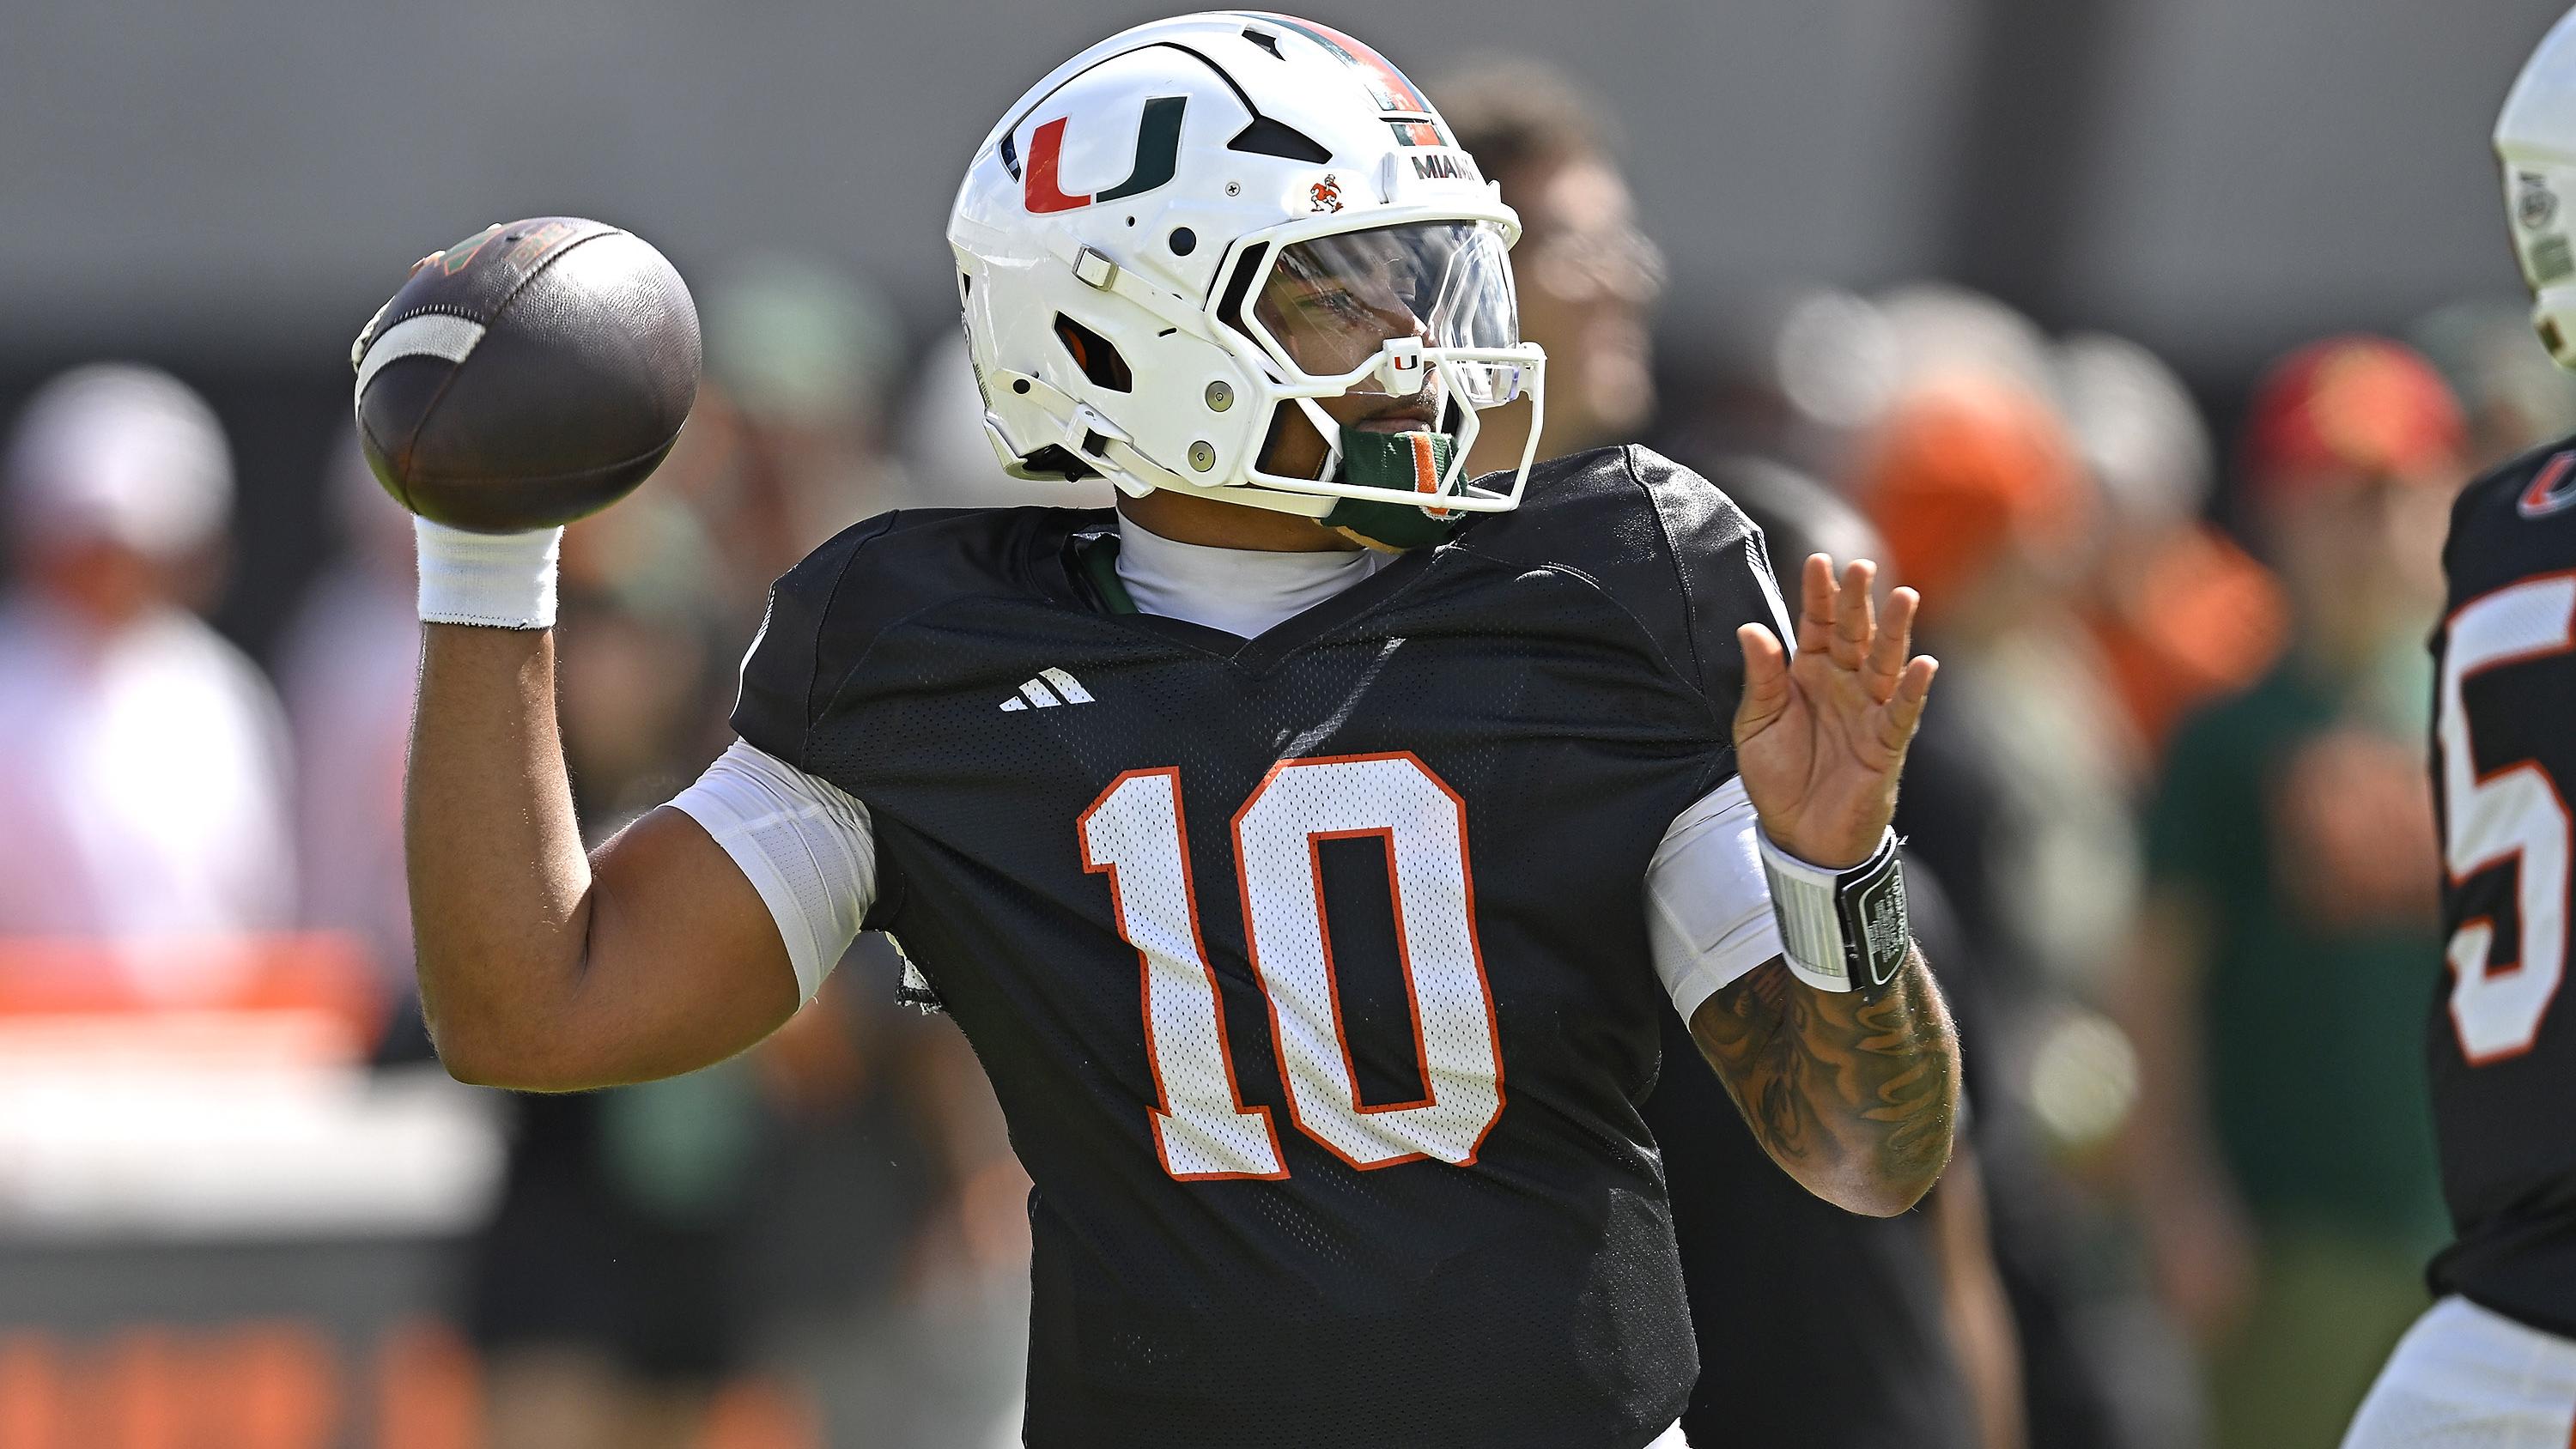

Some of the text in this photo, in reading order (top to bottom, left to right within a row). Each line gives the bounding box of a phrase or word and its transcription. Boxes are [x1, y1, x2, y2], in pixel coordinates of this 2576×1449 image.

[1024, 94, 1192, 214] U
[1394, 355, 1418, 370] U
[2439, 568, 2576, 1067] 5
[1077, 749, 1506, 1181] 10
